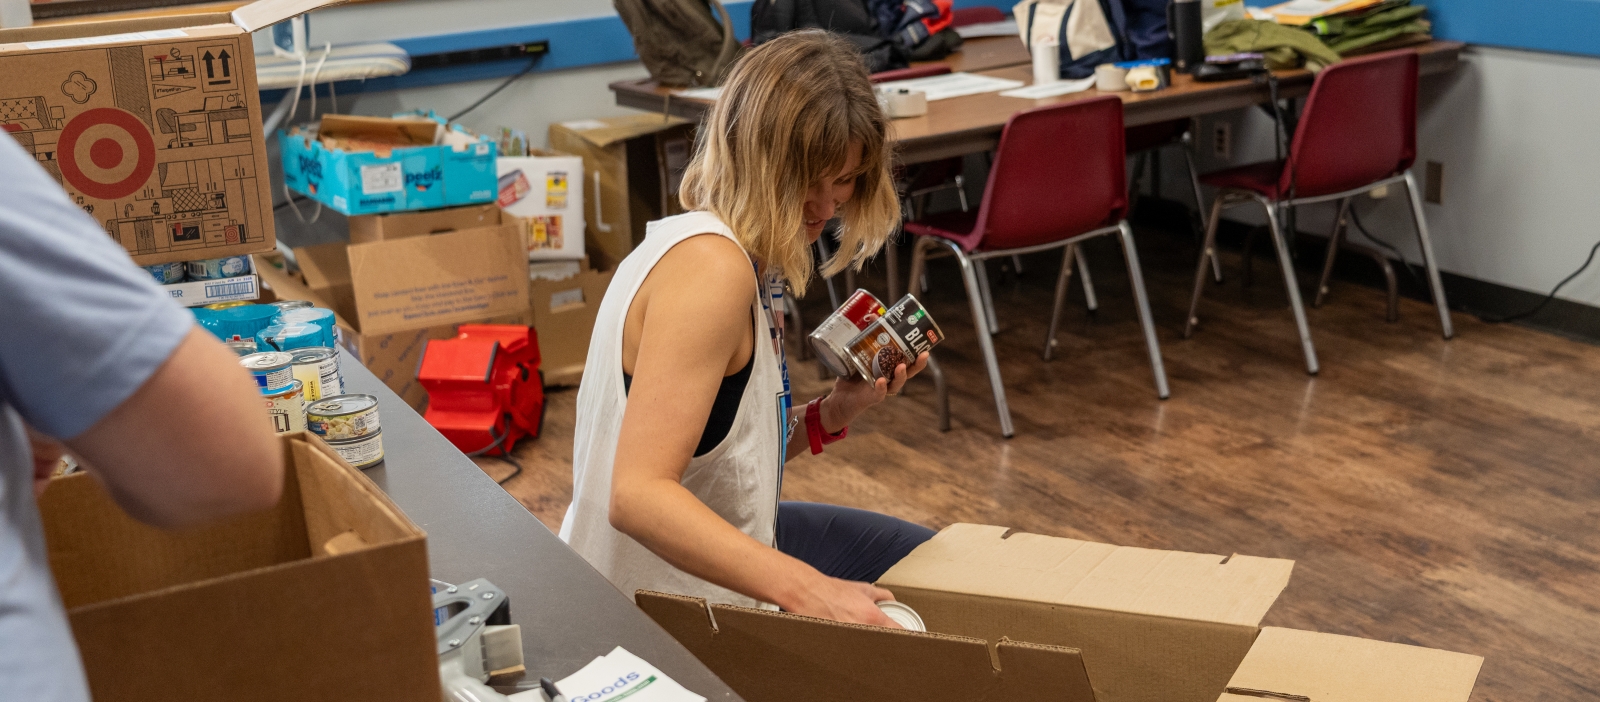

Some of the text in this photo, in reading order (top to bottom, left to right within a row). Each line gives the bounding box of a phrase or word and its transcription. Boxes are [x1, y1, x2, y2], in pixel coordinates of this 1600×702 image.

[404, 168, 442, 185] peelz
[167, 289, 183, 298] TER
[904, 326, 931, 356] BLAC
[571, 672, 640, 702] Goods
